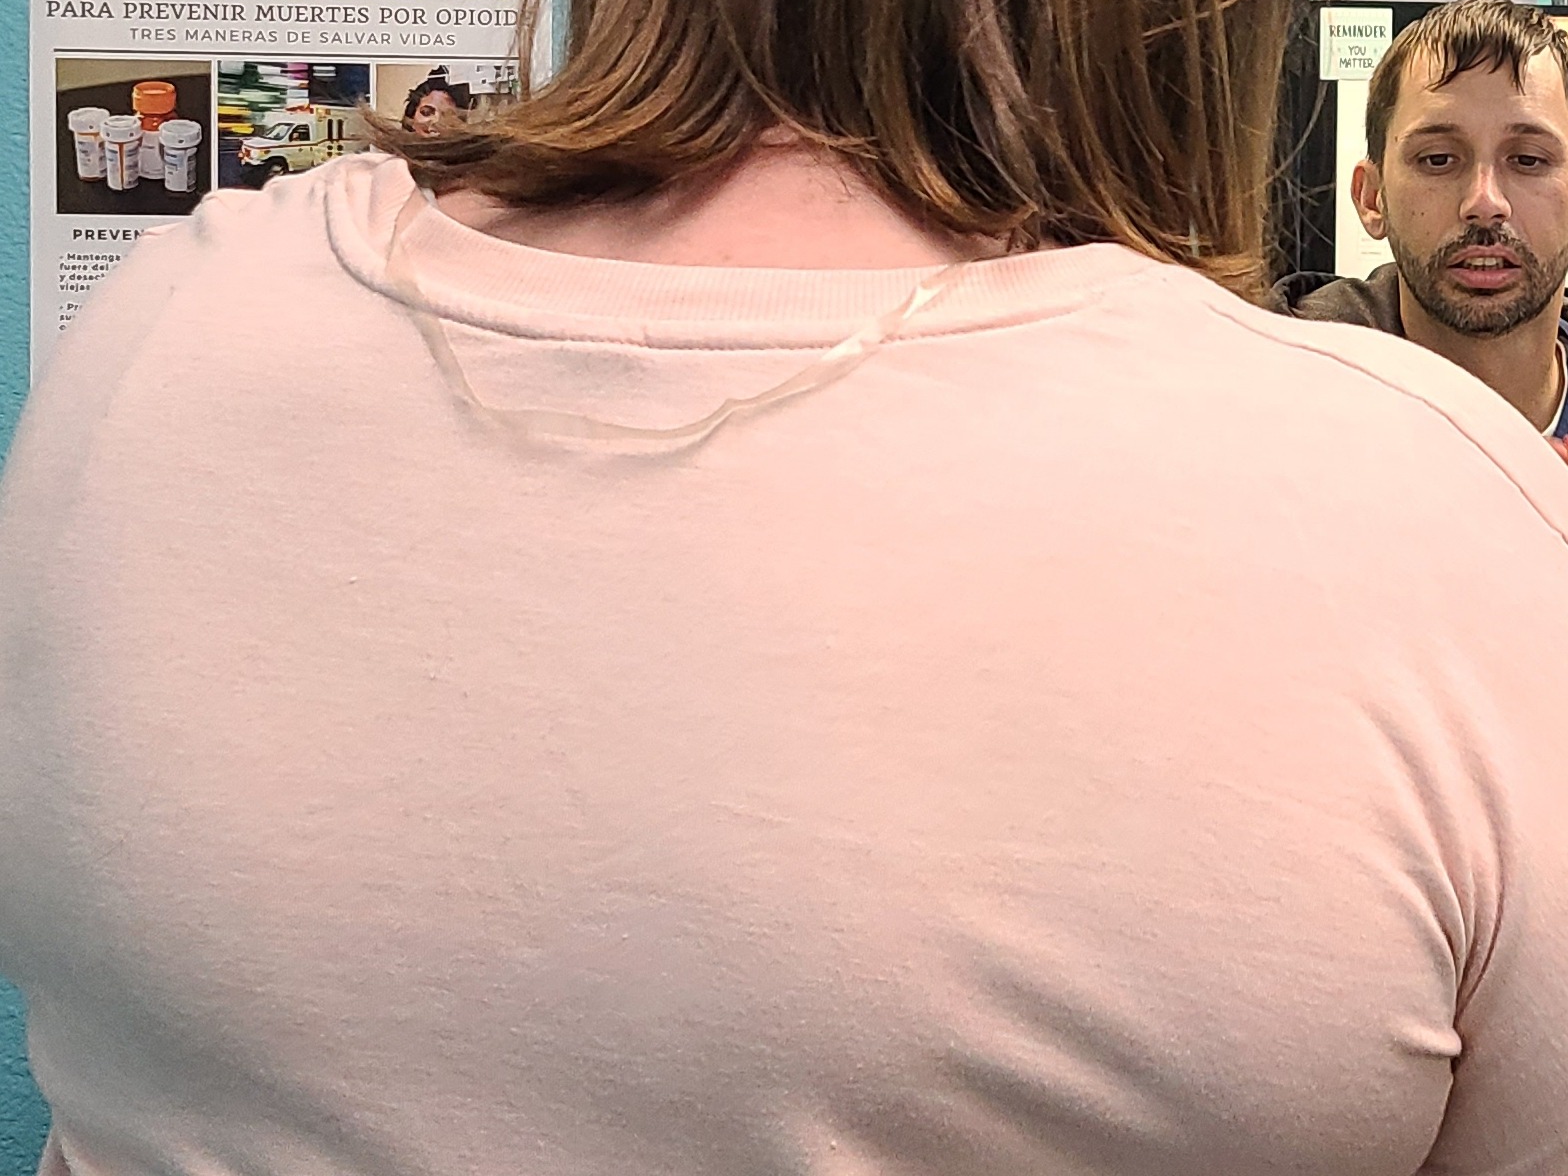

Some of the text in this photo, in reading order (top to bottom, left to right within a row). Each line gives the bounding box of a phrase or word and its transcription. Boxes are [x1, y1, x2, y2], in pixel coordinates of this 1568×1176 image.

[45, 0, 518, 26] PARA PREVENIR MUERTES POR OPIOID
[129, 27, 456, 46] TRES MANERAS DE SALVAR VIDAS
[1329, 24, 1387, 39] REMINDER
[1348, 45, 1366, 58] YOU
[1339, 57, 1376, 70] MATTER
